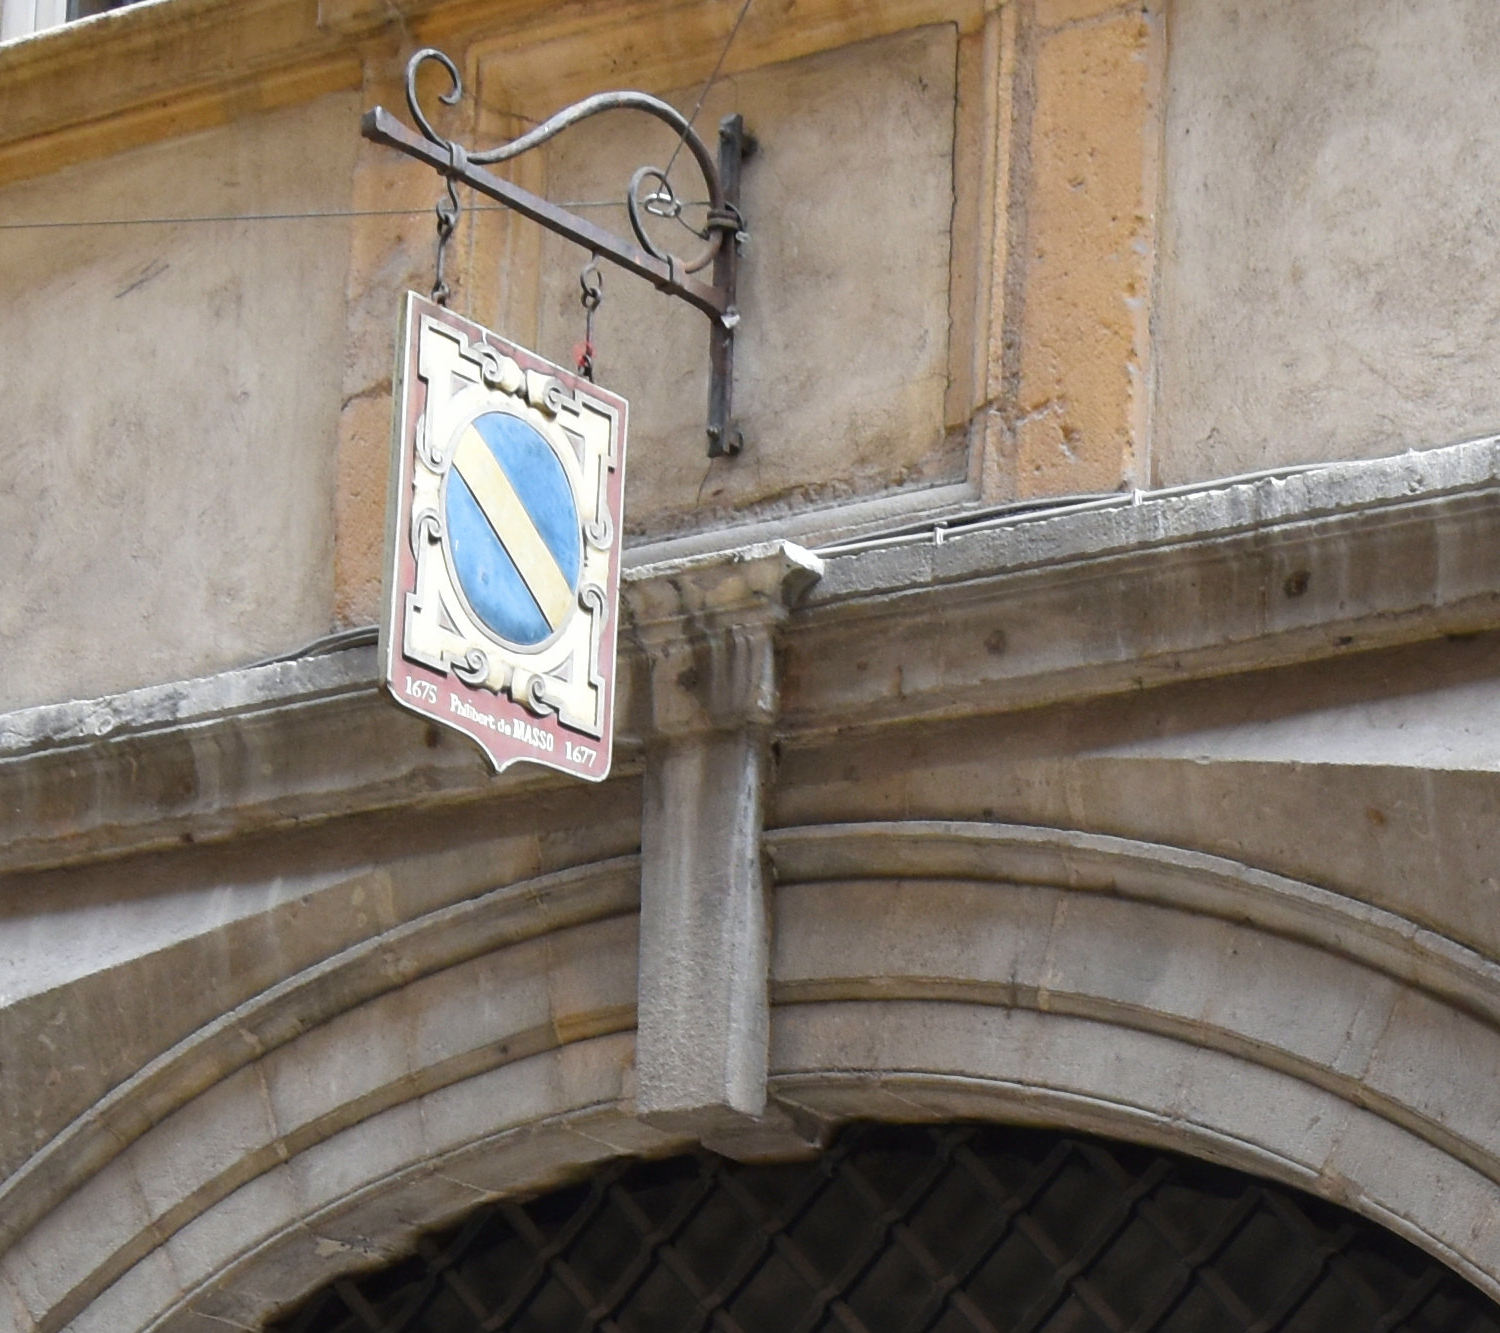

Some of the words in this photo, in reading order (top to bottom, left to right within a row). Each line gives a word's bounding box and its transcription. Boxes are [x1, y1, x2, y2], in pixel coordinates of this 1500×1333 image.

[404, 676, 438, 705] 1675
[449, 692, 496, 730] Philibert
[497, 719, 512, 737] de
[512, 718, 554, 753] MASSO
[565, 741, 597, 768] 1677
